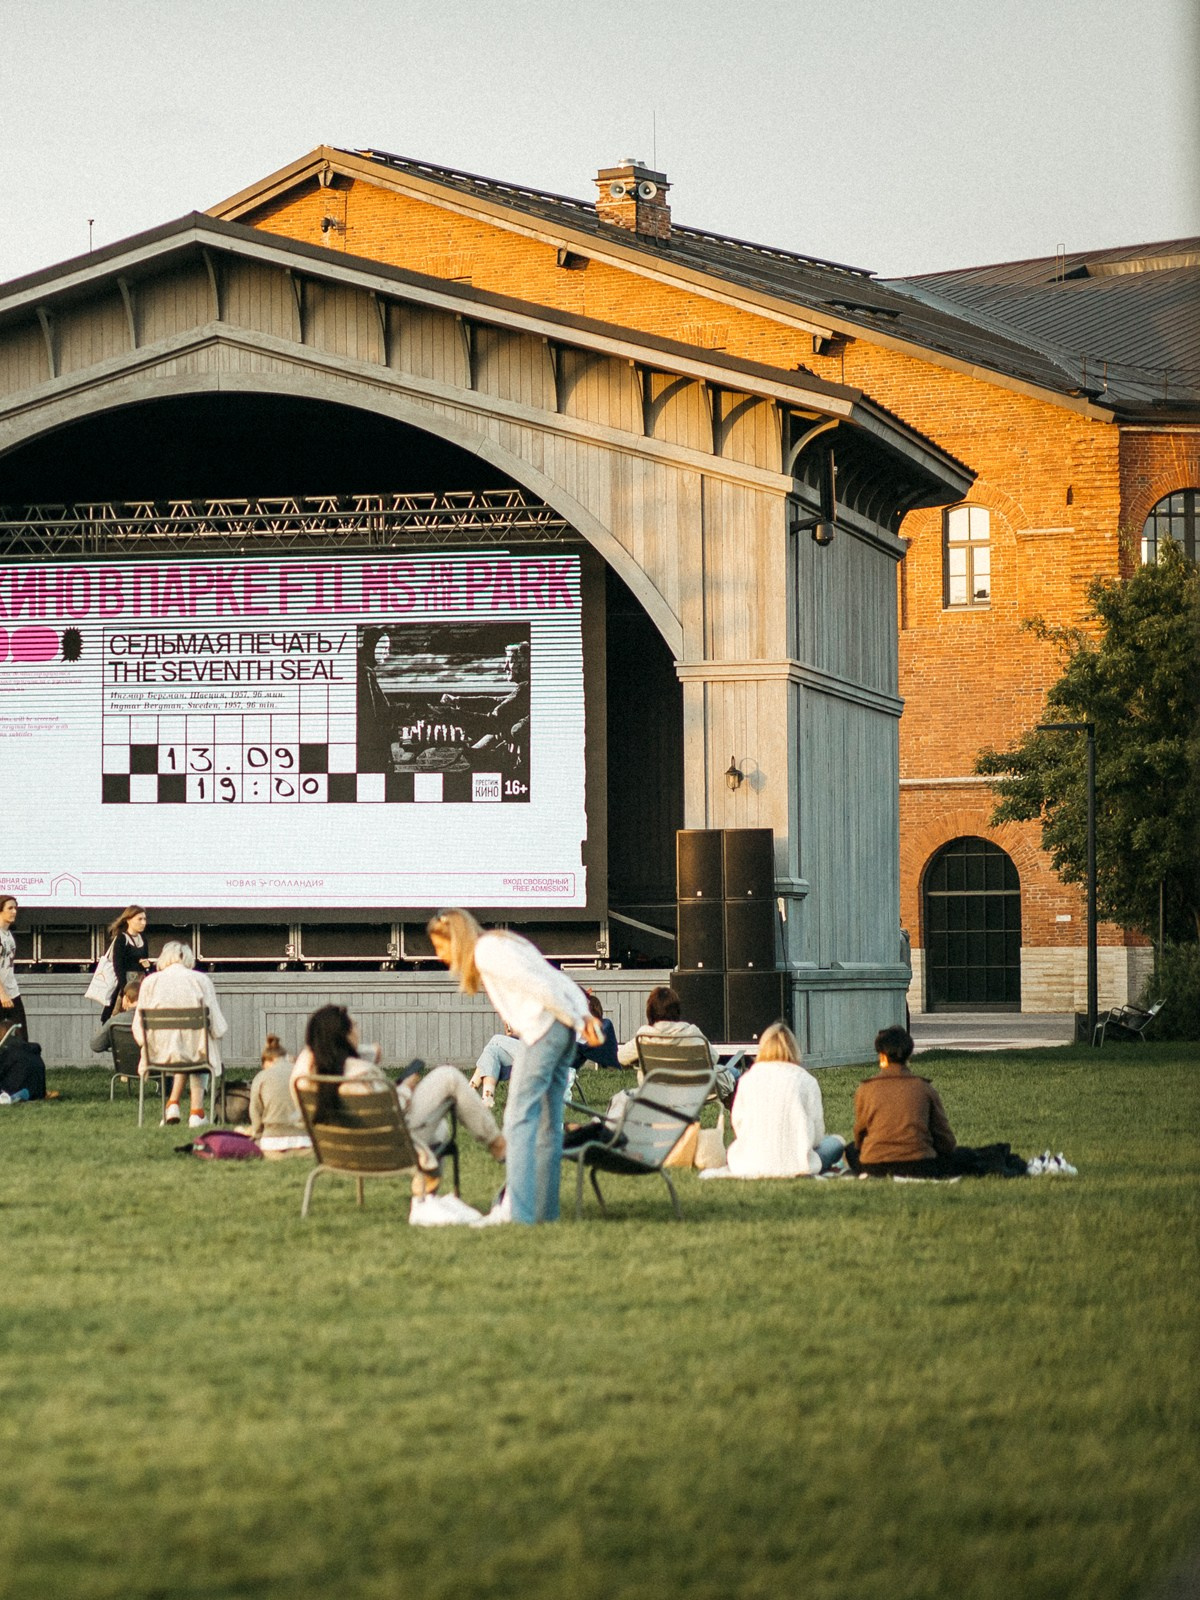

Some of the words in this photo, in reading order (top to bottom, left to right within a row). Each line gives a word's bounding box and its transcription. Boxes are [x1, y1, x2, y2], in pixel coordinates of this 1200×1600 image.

[427, 563, 453, 585] IN
[100, 566, 125, 618] В
[133, 564, 270, 617] ПАРКЕ
[279, 561, 417, 615] FILMS
[466, 560, 575, 611] PARK
[420, 586, 460, 611] THE
[109, 632, 231, 660] СЕДЬМАЯ
[238, 632, 333, 655] ПЕЧАТЬ
[108, 660, 156, 683] THE
[161, 659, 274, 682] SEVENTH
[280, 659, 344, 681] SEAL
[252, 690, 263, 699] 96
[110, 702, 141, 711] Ingmar
[246, 701, 256, 709] 96
[475, 785, 499, 798] КИНО
[504, 779, 528, 795] 16+
[20, 877, 44, 885] СЦЕНА
[226, 879, 257, 887] НОВАЯ
[268, 879, 324, 888] ГОЛЛАНДИЯ
[523, 877, 569, 886] СВОБОДНЫЙ
